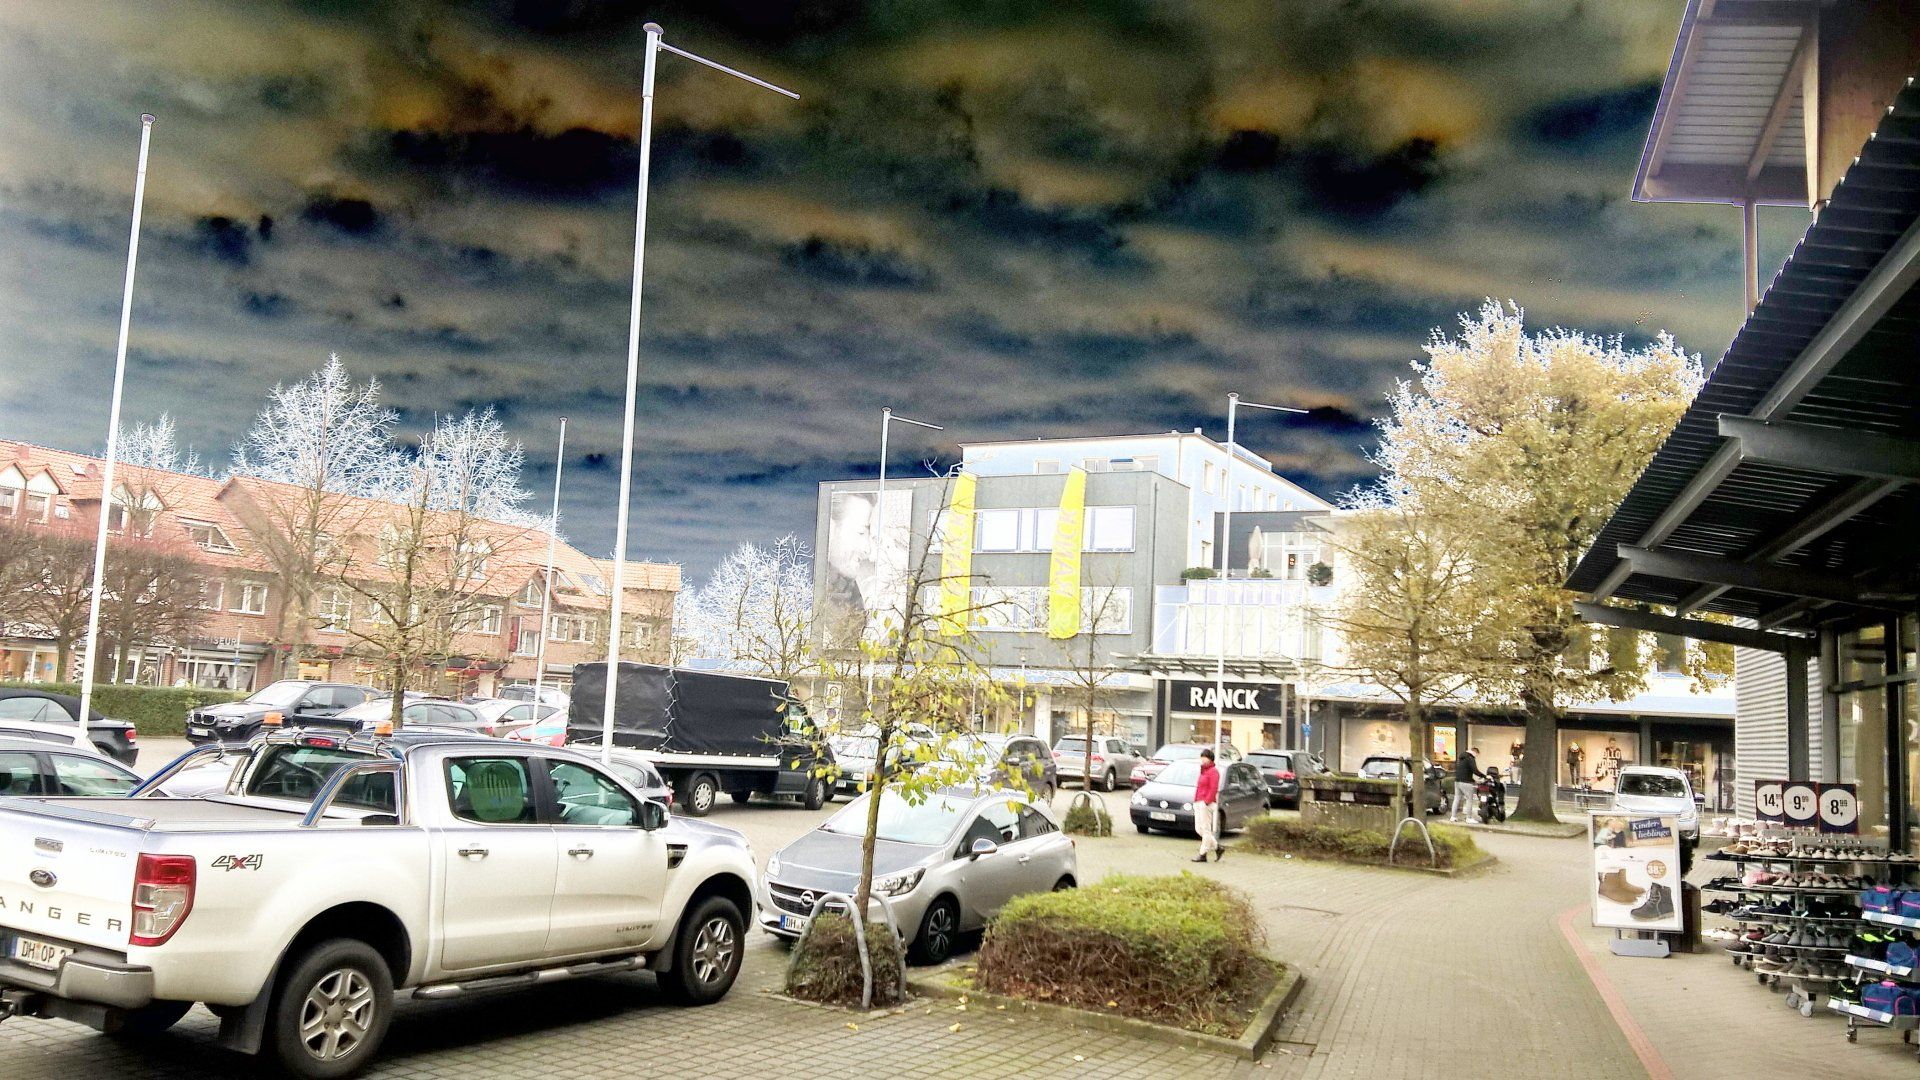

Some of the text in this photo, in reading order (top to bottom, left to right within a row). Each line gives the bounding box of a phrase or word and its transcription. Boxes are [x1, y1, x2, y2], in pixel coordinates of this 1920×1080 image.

[1190, 687, 1260, 710] RANCK
[21, 940, 36, 959] DH
[41, 944, 55, 963] OP
